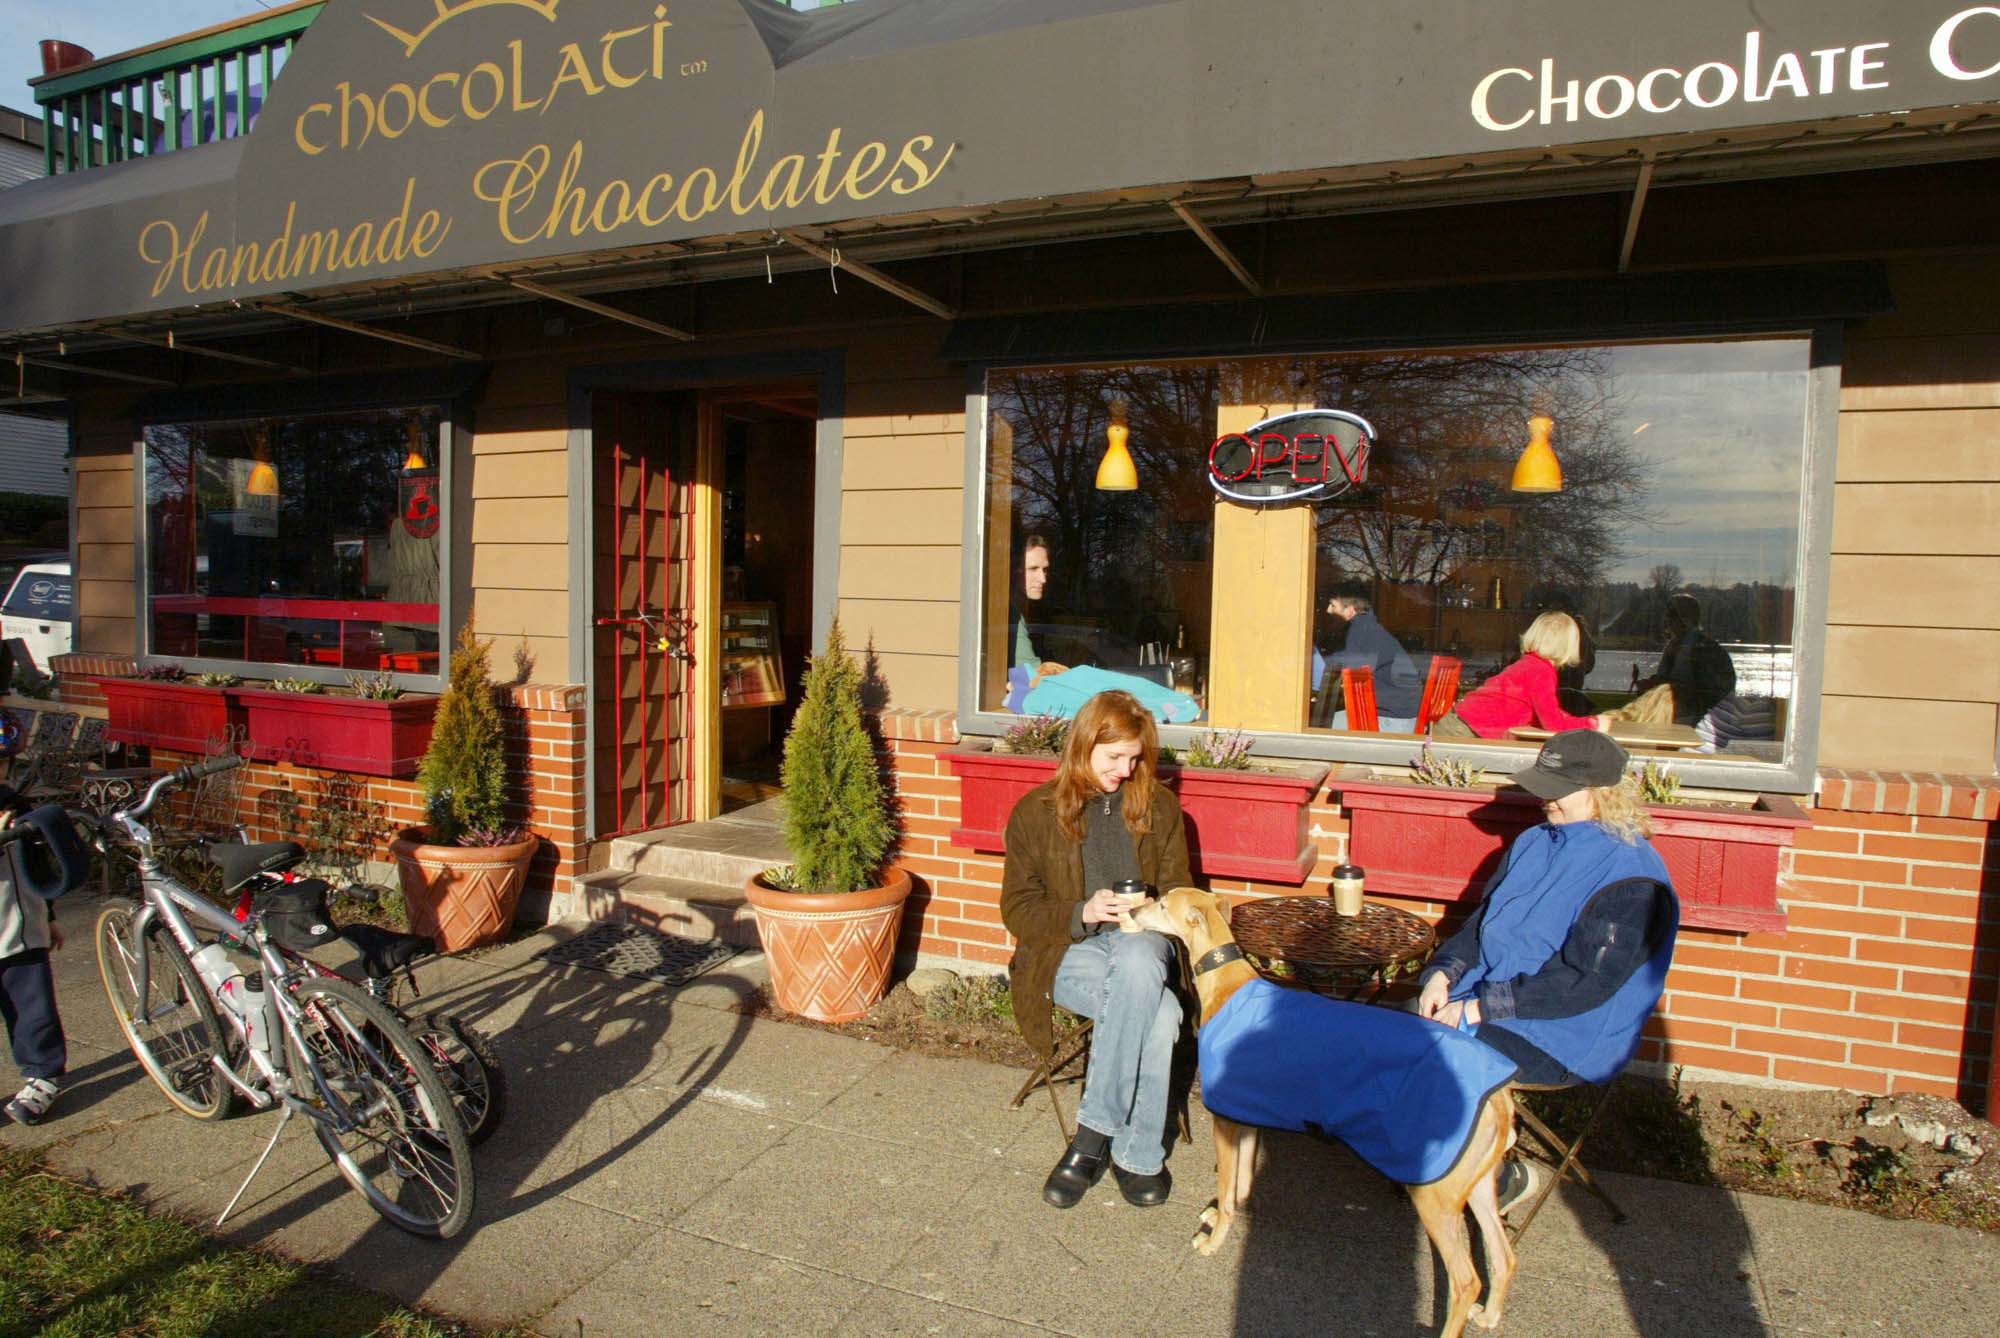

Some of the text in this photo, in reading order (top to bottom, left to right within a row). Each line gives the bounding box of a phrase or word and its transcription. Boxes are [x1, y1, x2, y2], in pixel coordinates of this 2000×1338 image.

[138, 108, 956, 298] Handmade Chocolates
[1209, 432, 1367, 484] OPEN
